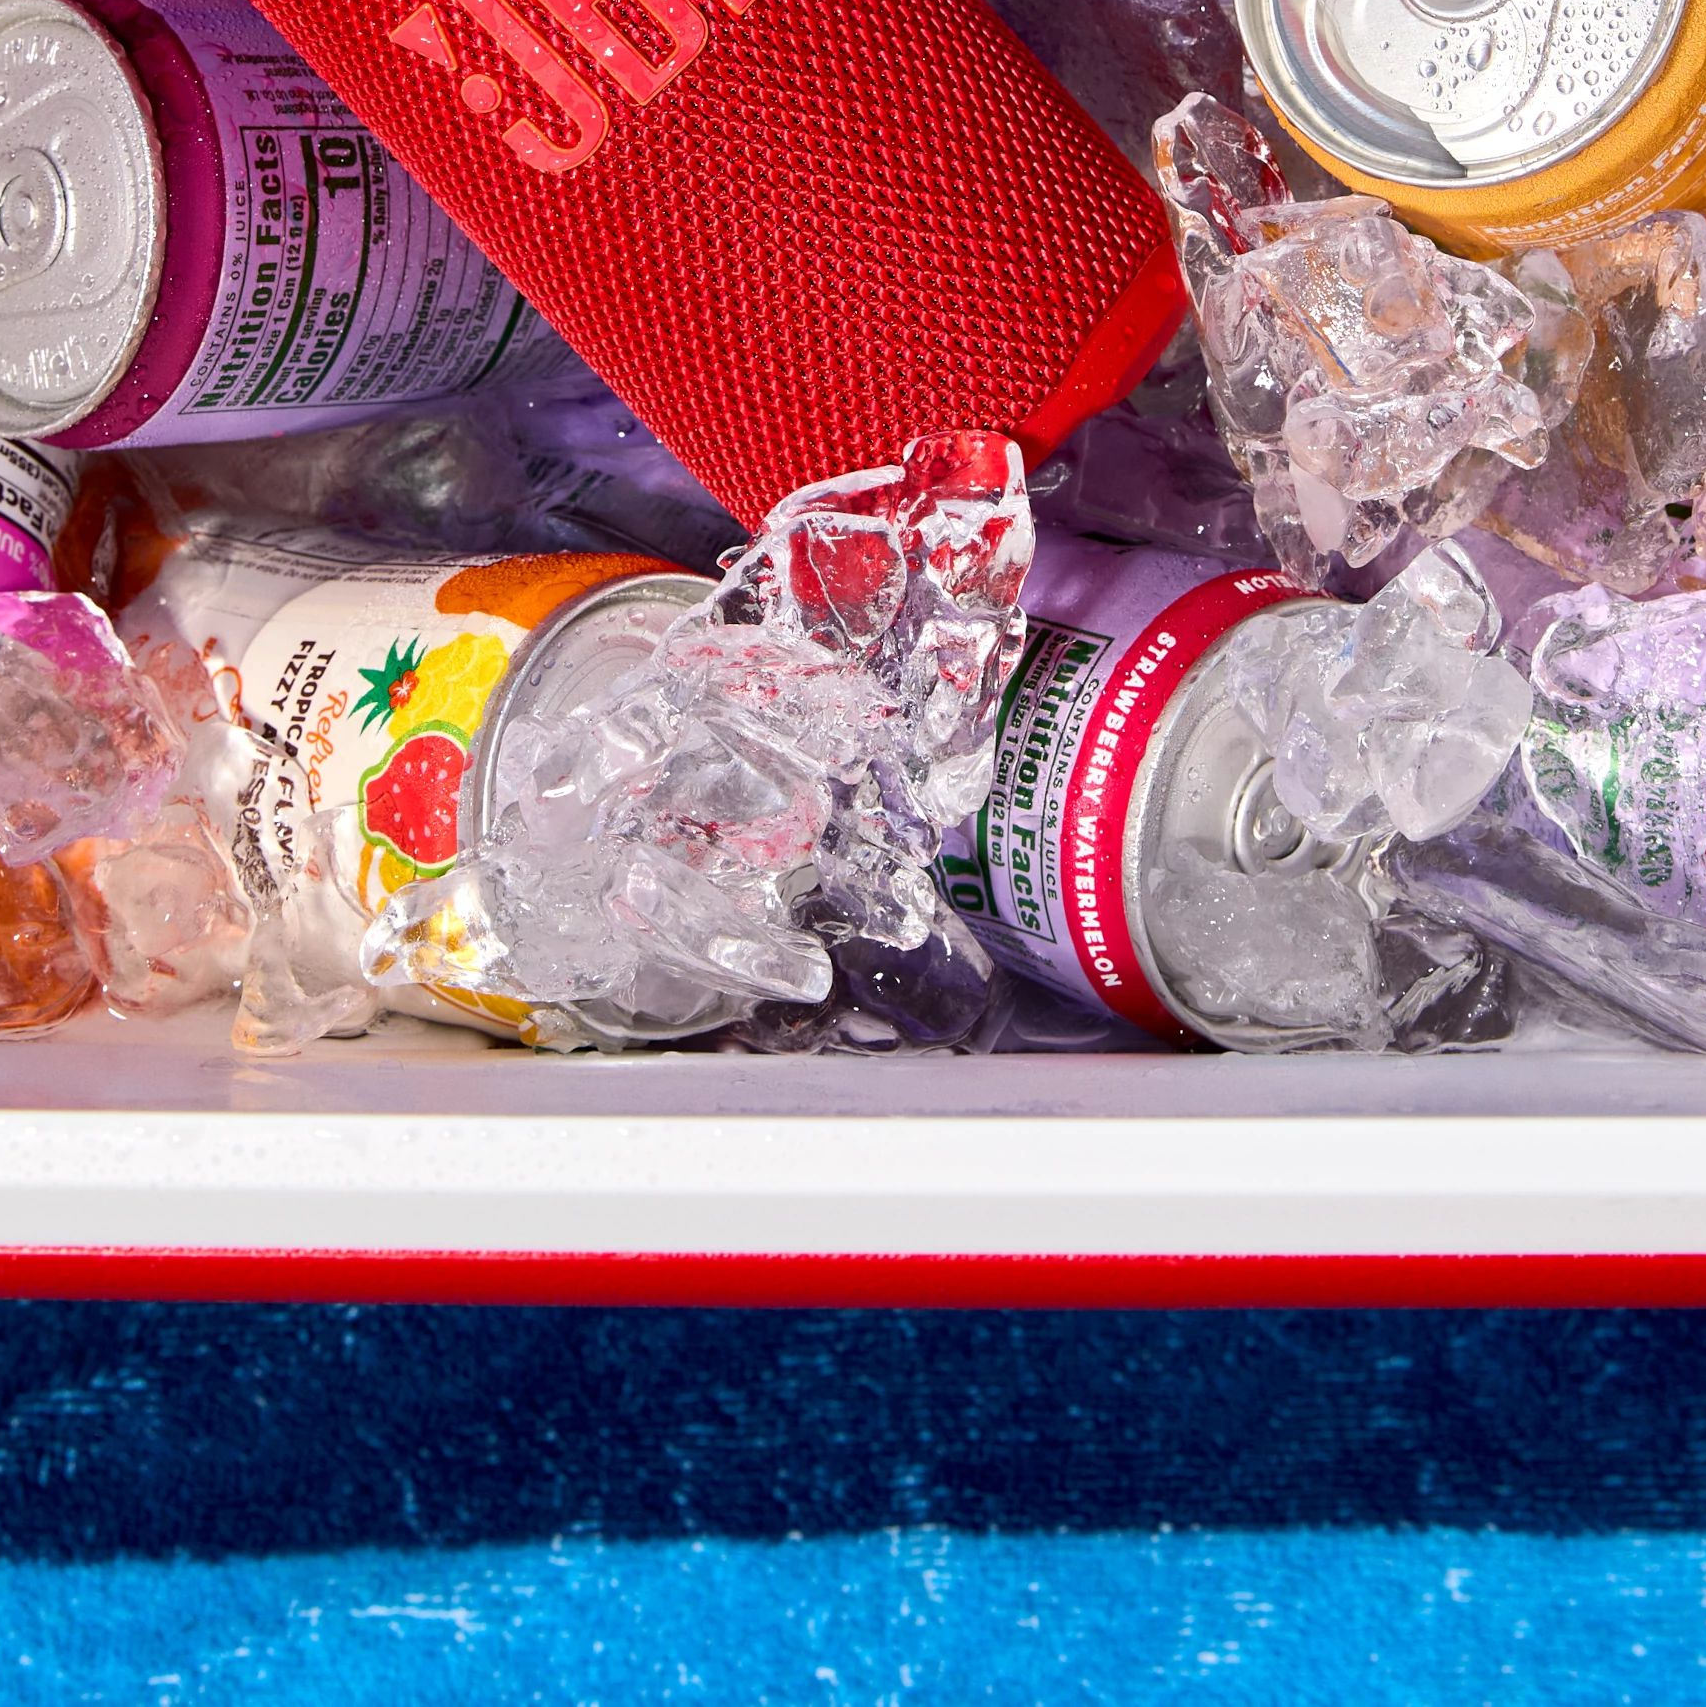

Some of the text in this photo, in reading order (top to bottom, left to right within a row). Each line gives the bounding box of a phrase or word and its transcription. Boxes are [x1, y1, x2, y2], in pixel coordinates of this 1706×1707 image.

[291, 194, 307, 222] oz)
[373, 190, 388, 227] Daily
[1482, 176, 1646, 234] Nutrition
[191, 180, 246, 388] CONTAINS 0% JUICE
[193, 134, 281, 408] Nutrition Facts
[274, 136, 361, 404] Calories 10
[285, 244, 302, 272] (12
[277, 276, 297, 312] Can
[391, 280, 438, 374] Carbohydrate
[427, 257, 443, 278] 2g
[454, 308, 471, 326] 0g
[257, 365, 293, 405] Amount
[300, 287, 327, 340] serving
[262, 322, 281, 360] size
[349, 350, 371, 377] Fat
[225, 360, 268, 407] Serving
[270, 640, 317, 713] FIZZY
[1022, 632, 1068, 693] Serving
[1011, 695, 1031, 730] size
[1013, 638, 1091, 811] Nutrition
[273, 649, 336, 874] TROPICA FLAVO
[994, 748, 1014, 786] Can
[1044, 678, 1101, 902] CONTAINS 0% JUICE
[991, 788, 1011, 820] (12
[1074, 631, 1177, 989] STRAWBERRY WATERMELON
[941, 855, 986, 912] 10
[989, 843, 1006, 867] oz)
[1010, 824, 1042, 932] Facts
